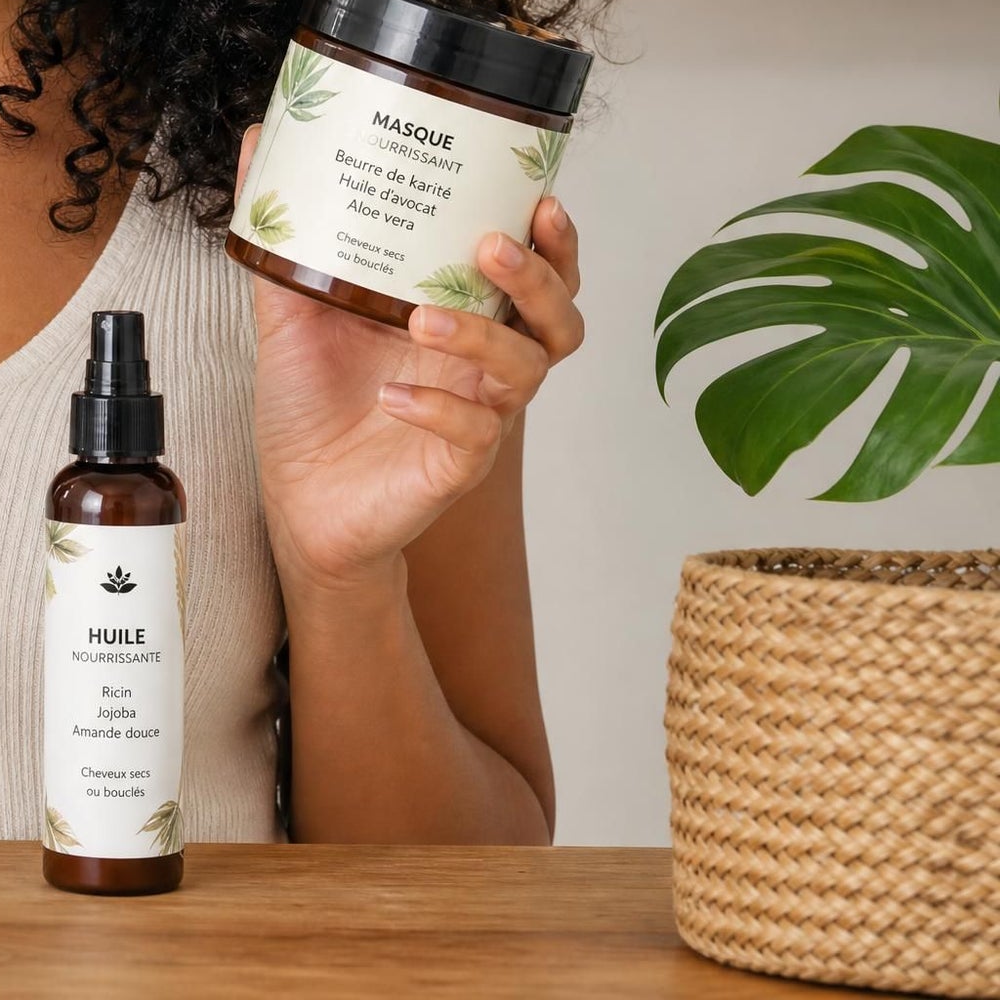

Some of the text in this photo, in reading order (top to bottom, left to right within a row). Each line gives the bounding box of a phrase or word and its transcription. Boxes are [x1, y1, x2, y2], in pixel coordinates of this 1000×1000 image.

[372, 111, 454, 151] MASQUE
[357, 131, 463, 174] OURRISSAINT
[335, 149, 451, 200] Beurre de karité
[339, 173, 437, 217] Huile d'avocat
[347, 199, 414, 231] Aloe vera
[337, 231, 405, 262] Cheveux secs
[337, 251, 394, 276] ou bouclés
[89, 628, 145, 645] HUILE
[73, 651, 161, 663] NOURRISSANTE
[102, 686, 131, 698] Ricin
[97, 706, 136, 721] Jojoba
[73, 725, 159, 739] Amande douce
[81, 767, 150, 779] Cheveux secs
[87, 786, 145, 798] ou bouclés
